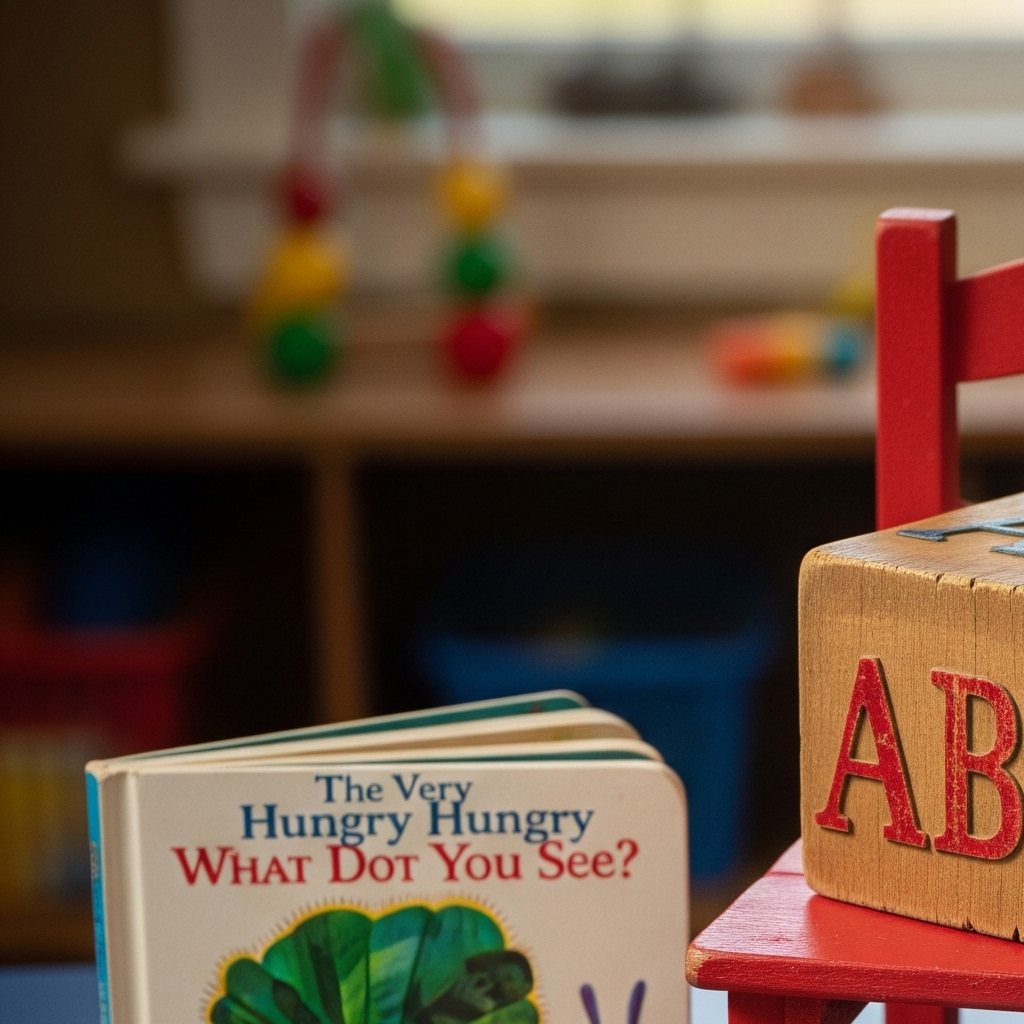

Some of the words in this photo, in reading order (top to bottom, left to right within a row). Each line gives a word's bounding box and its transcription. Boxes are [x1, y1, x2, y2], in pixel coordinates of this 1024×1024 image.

[315, 773, 384, 803] The
[392, 772, 473, 804] Very
[240, 803, 413, 846] Hungry
[427, 801, 595, 844] Hungry
[538, 837, 640, 881] See?
